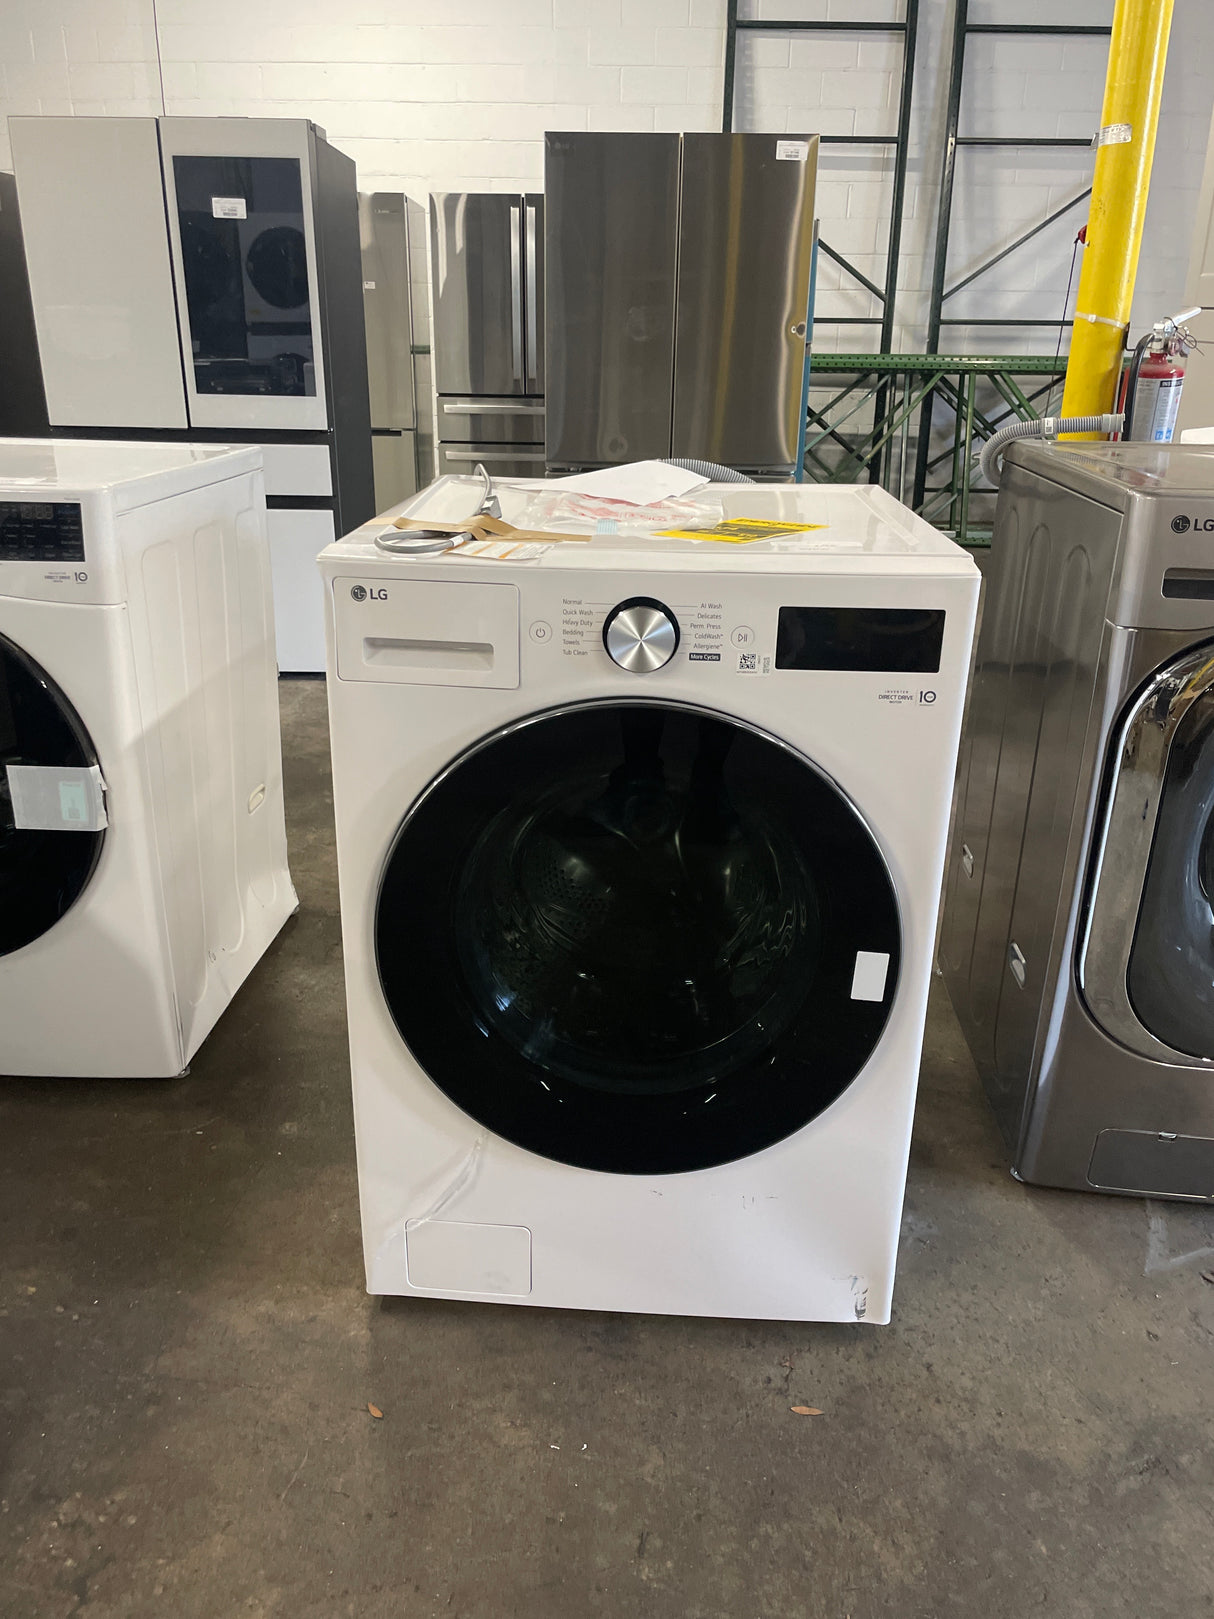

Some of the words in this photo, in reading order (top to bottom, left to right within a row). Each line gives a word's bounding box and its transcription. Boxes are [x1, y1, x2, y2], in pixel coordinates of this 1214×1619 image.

[1194, 518, 1214, 532] LG
[370, 588, 388, 601] LG
[562, 619, 579, 627] Heavy
[562, 629, 584, 637] Bedding
[920, 691, 936, 703] 10
